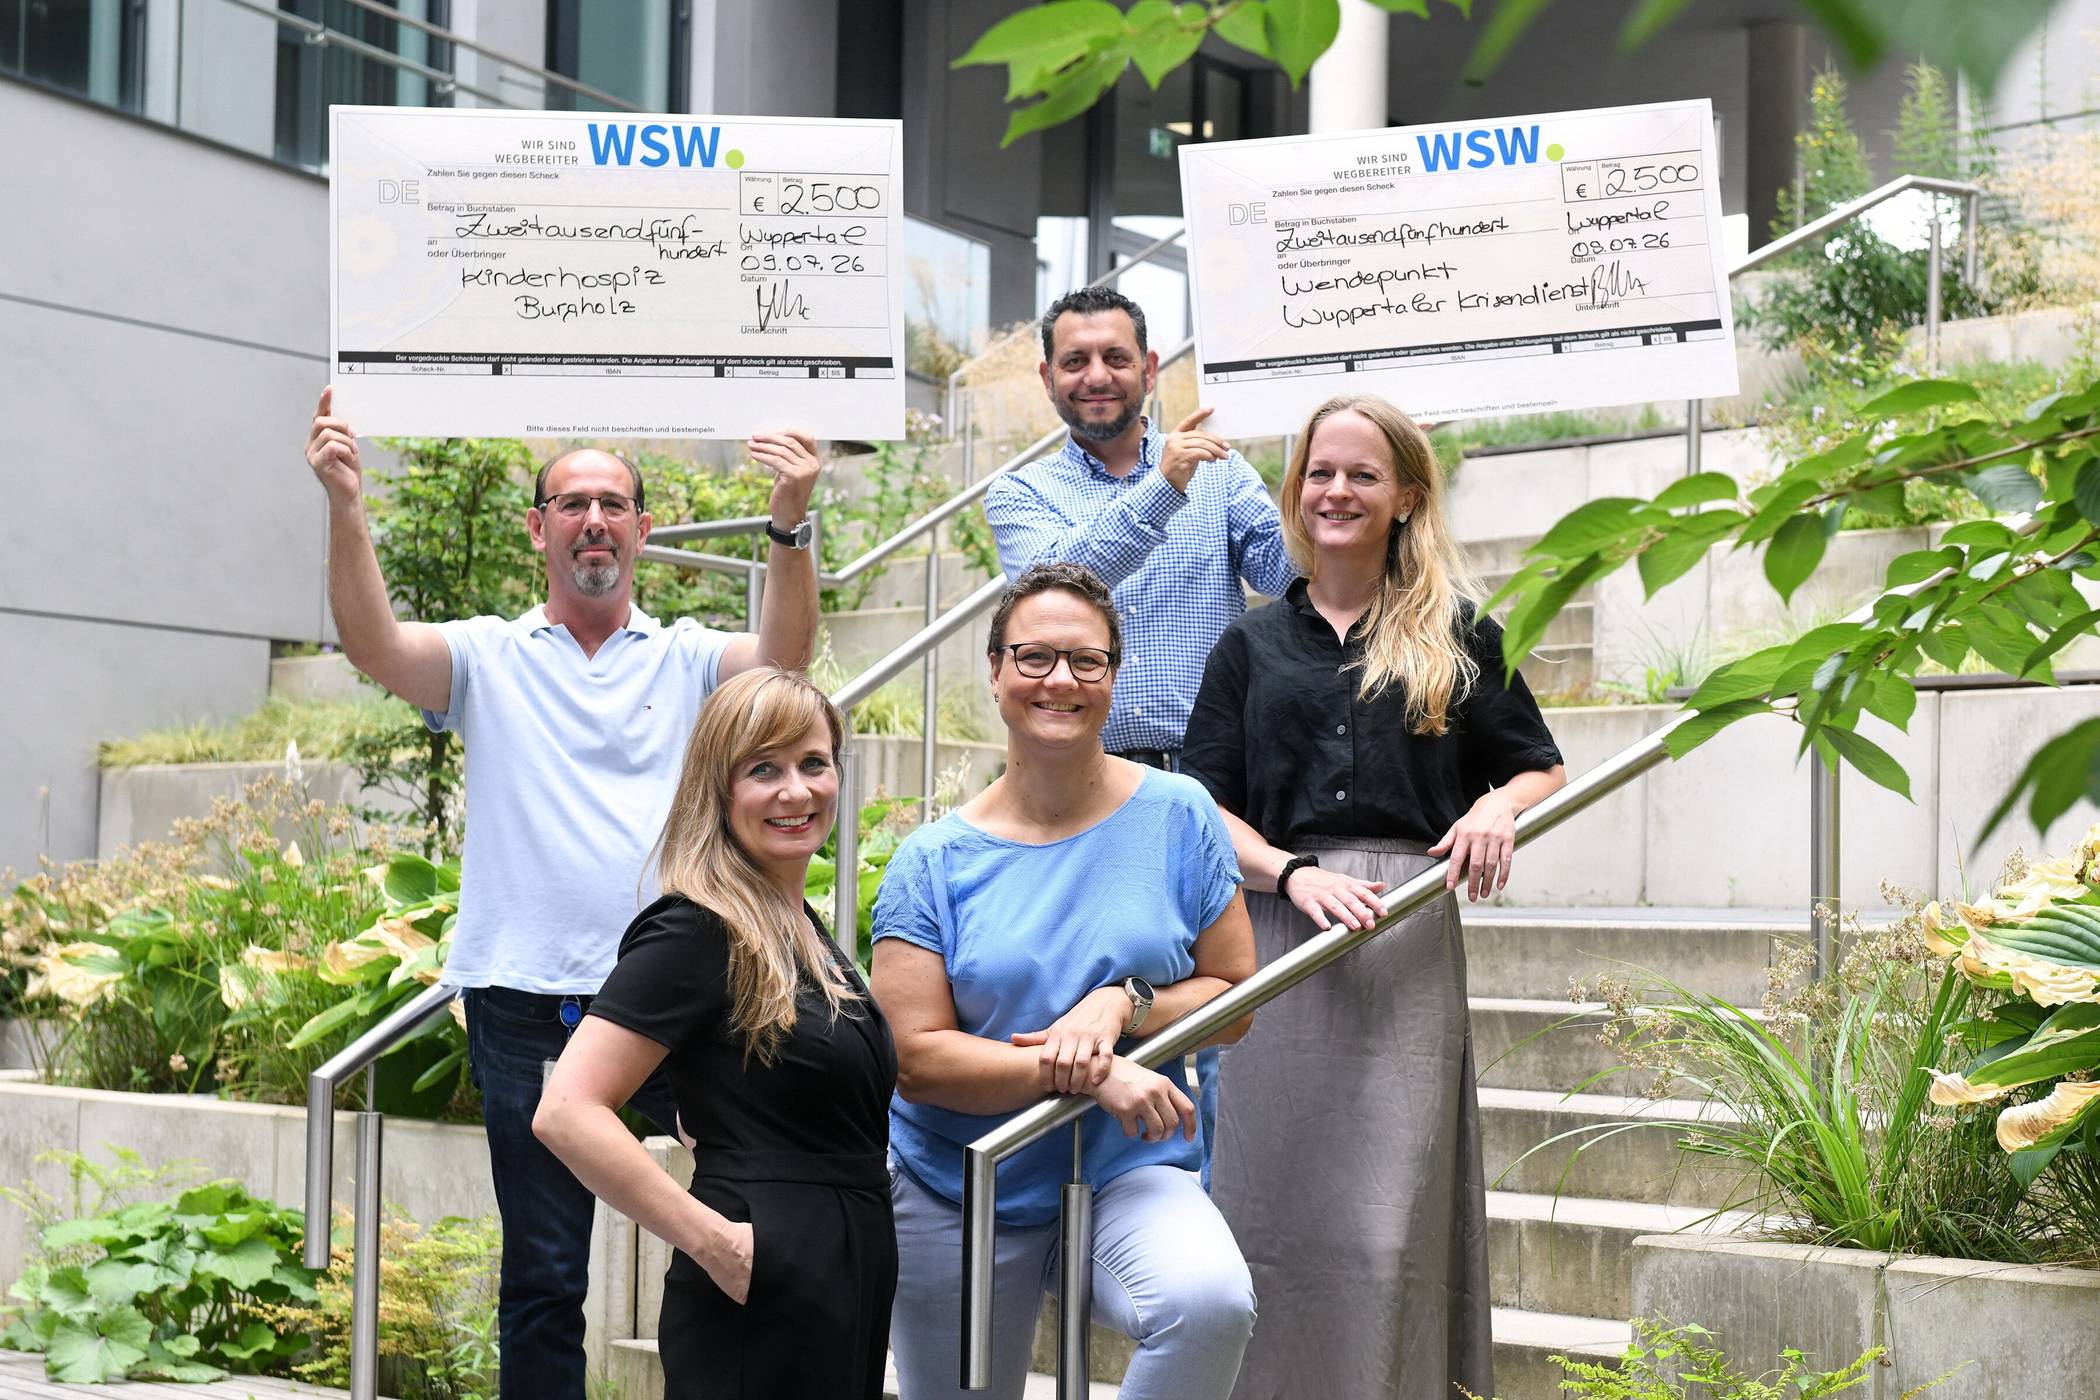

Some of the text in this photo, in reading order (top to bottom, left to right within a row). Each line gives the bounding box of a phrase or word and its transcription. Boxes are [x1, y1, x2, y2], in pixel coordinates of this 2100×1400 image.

[521, 140, 576, 150] WIR SIND
[495, 153, 579, 165] WEGBEREITER
[1356, 153, 1408, 165] WIR SIND
[427, 168, 560, 180] Zahlen Sie gegen diesen Scheck
[1333, 165, 1412, 180] WEGBEREITER
[782, 176, 803, 184] Betrag
[1605, 164, 1699, 197] 2.500
[378, 179, 420, 205] DE
[1272, 182, 1395, 198] Zahlen Sie gegen diesen Scheck
[1575, 183, 1587, 198] €
[753, 196, 765, 212] €
[780, 183, 881, 214] 2.500
[427, 203, 516, 213] Betrag in Buchstaben
[1228, 202, 1268, 226] DE
[1274, 216, 1357, 229] Betrag in Buchstaben
[739, 222, 867, 250] Wuppertal
[427, 248, 507, 259] oder Überbringer
[659, 240, 728, 260] hundert
[1277, 257, 1351, 270] oder Überbringer
[1570, 255, 1596, 264] Datum
[740, 275, 767, 283] Datum
[1282, 261, 1458, 296] Wendepunkt
[514, 295, 636, 323] Burgholz
[1283, 292, 1447, 328] Wuppertaler
[1457, 276, 1590, 312] Krisendienst
[1575, 301, 1620, 312] Untershrift
[740, 326, 788, 335] Unterschrift
[1268, 358, 1305, 368] vorgedruckte
[1306, 355, 1338, 364] Schecktext
[1353, 352, 1368, 360] nicht
[1476, 341, 1499, 350] Angabe
[1620, 328, 1635, 336] nicht
[396, 354, 407, 362] Der
[408, 355, 450, 363] vorgedruckte
[451, 355, 486, 363] Schecktext
[487, 355, 500, 363] darf
[517, 356, 545, 364] geändert
[547, 356, 561, 364] oder
[562, 356, 595, 365] gestrichen
[634, 357, 658, 365] Angabe
[675, 357, 715, 366] Zahlungsfrist
[742, 358, 765, 366] Scheck
[766, 358, 776, 366] gilt
[803, 359, 842, 367] geschrieben.
[1441, 408, 1459, 416] nicht
[1460, 405, 1500, 415] beschriften
[1517, 400, 1558, 409] bestempeln
[526, 425, 544, 433] Bitte
[546, 425, 571, 433] dieses
[572, 425, 589, 433] Feld
[611, 426, 654, 434] beschriften
[671, 426, 715, 435] bestempeln
